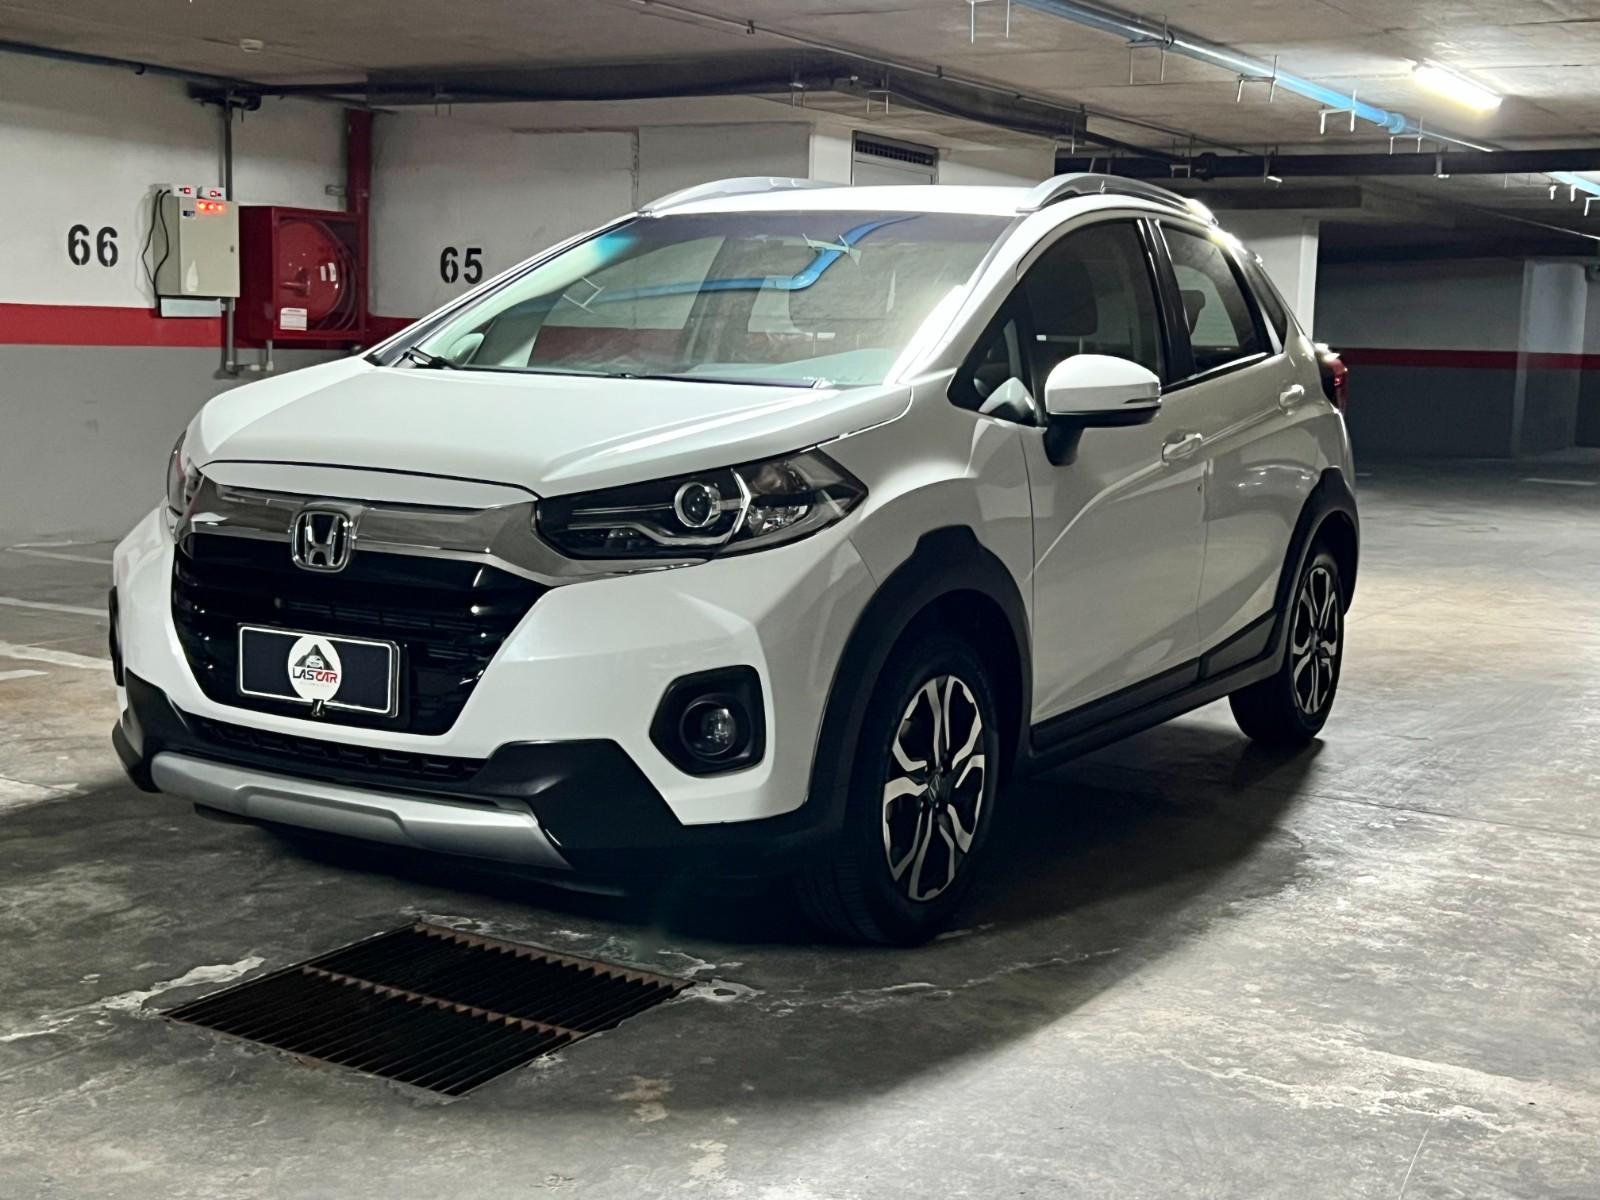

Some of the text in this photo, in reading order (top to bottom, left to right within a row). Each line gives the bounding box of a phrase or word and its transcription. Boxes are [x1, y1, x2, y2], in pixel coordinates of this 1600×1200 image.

[68, 224, 118, 267] 66
[440, 246, 483, 285] 65
[292, 667, 338, 683] LASCAR
